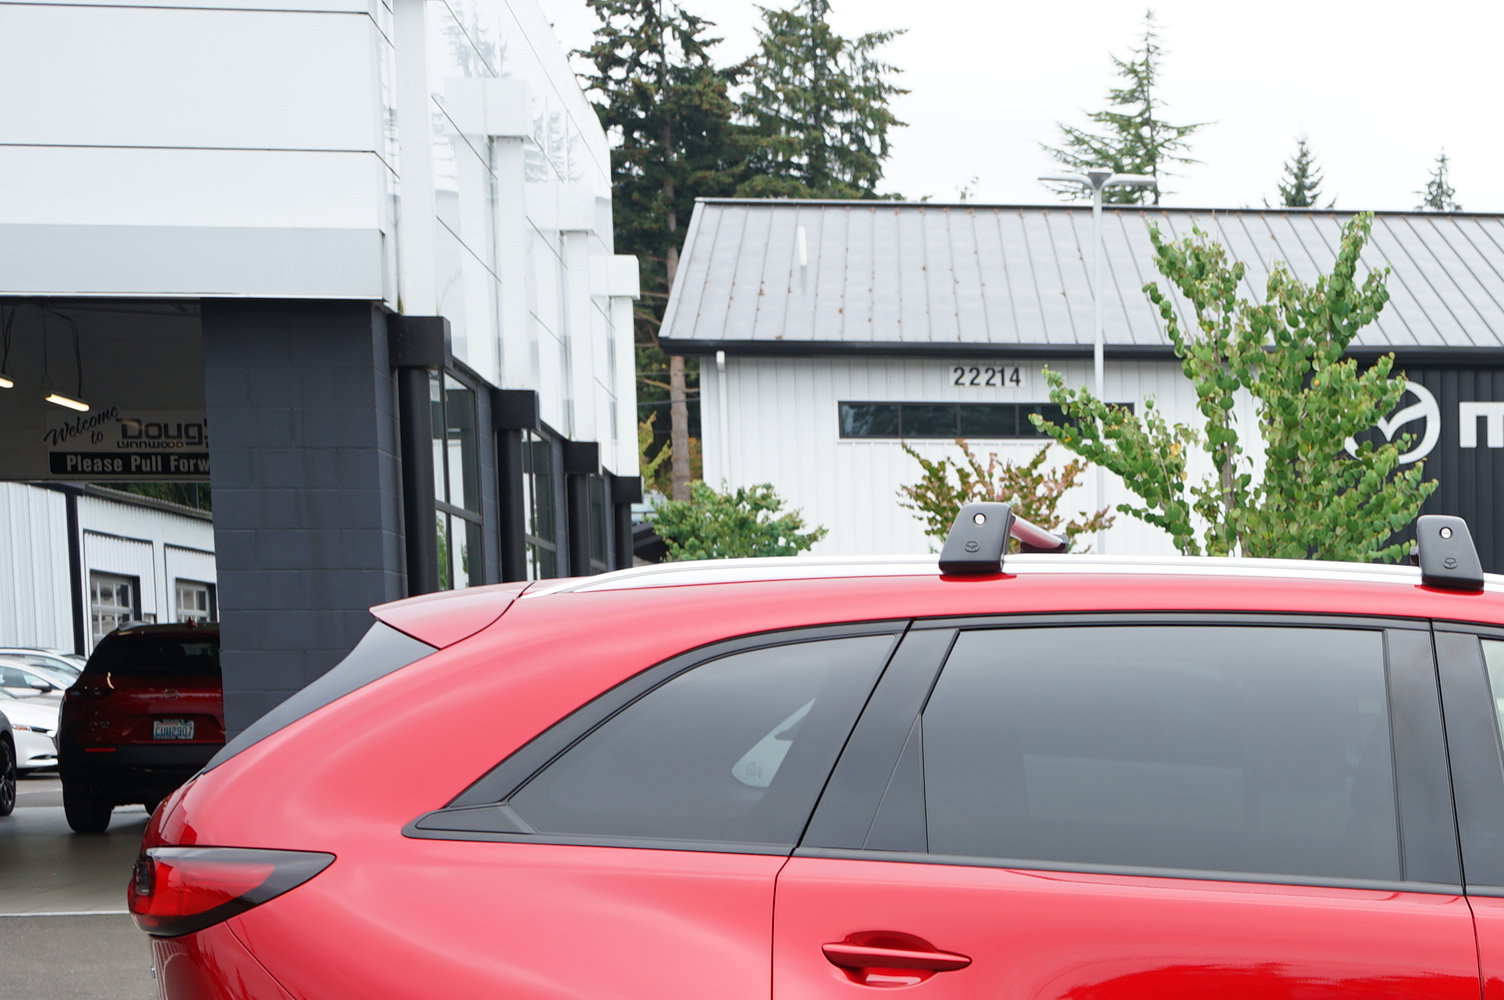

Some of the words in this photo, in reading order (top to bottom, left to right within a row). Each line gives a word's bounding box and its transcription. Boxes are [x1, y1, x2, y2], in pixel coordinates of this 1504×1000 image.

[953, 367, 1022, 387] 22214
[43, 406, 119, 447] Welcome
[115, 418, 208, 446] Doug'
[91, 430, 104, 446] to
[66, 454, 123, 473] Please
[131, 454, 162, 473] Pull
[170, 454, 210, 473] Forw
